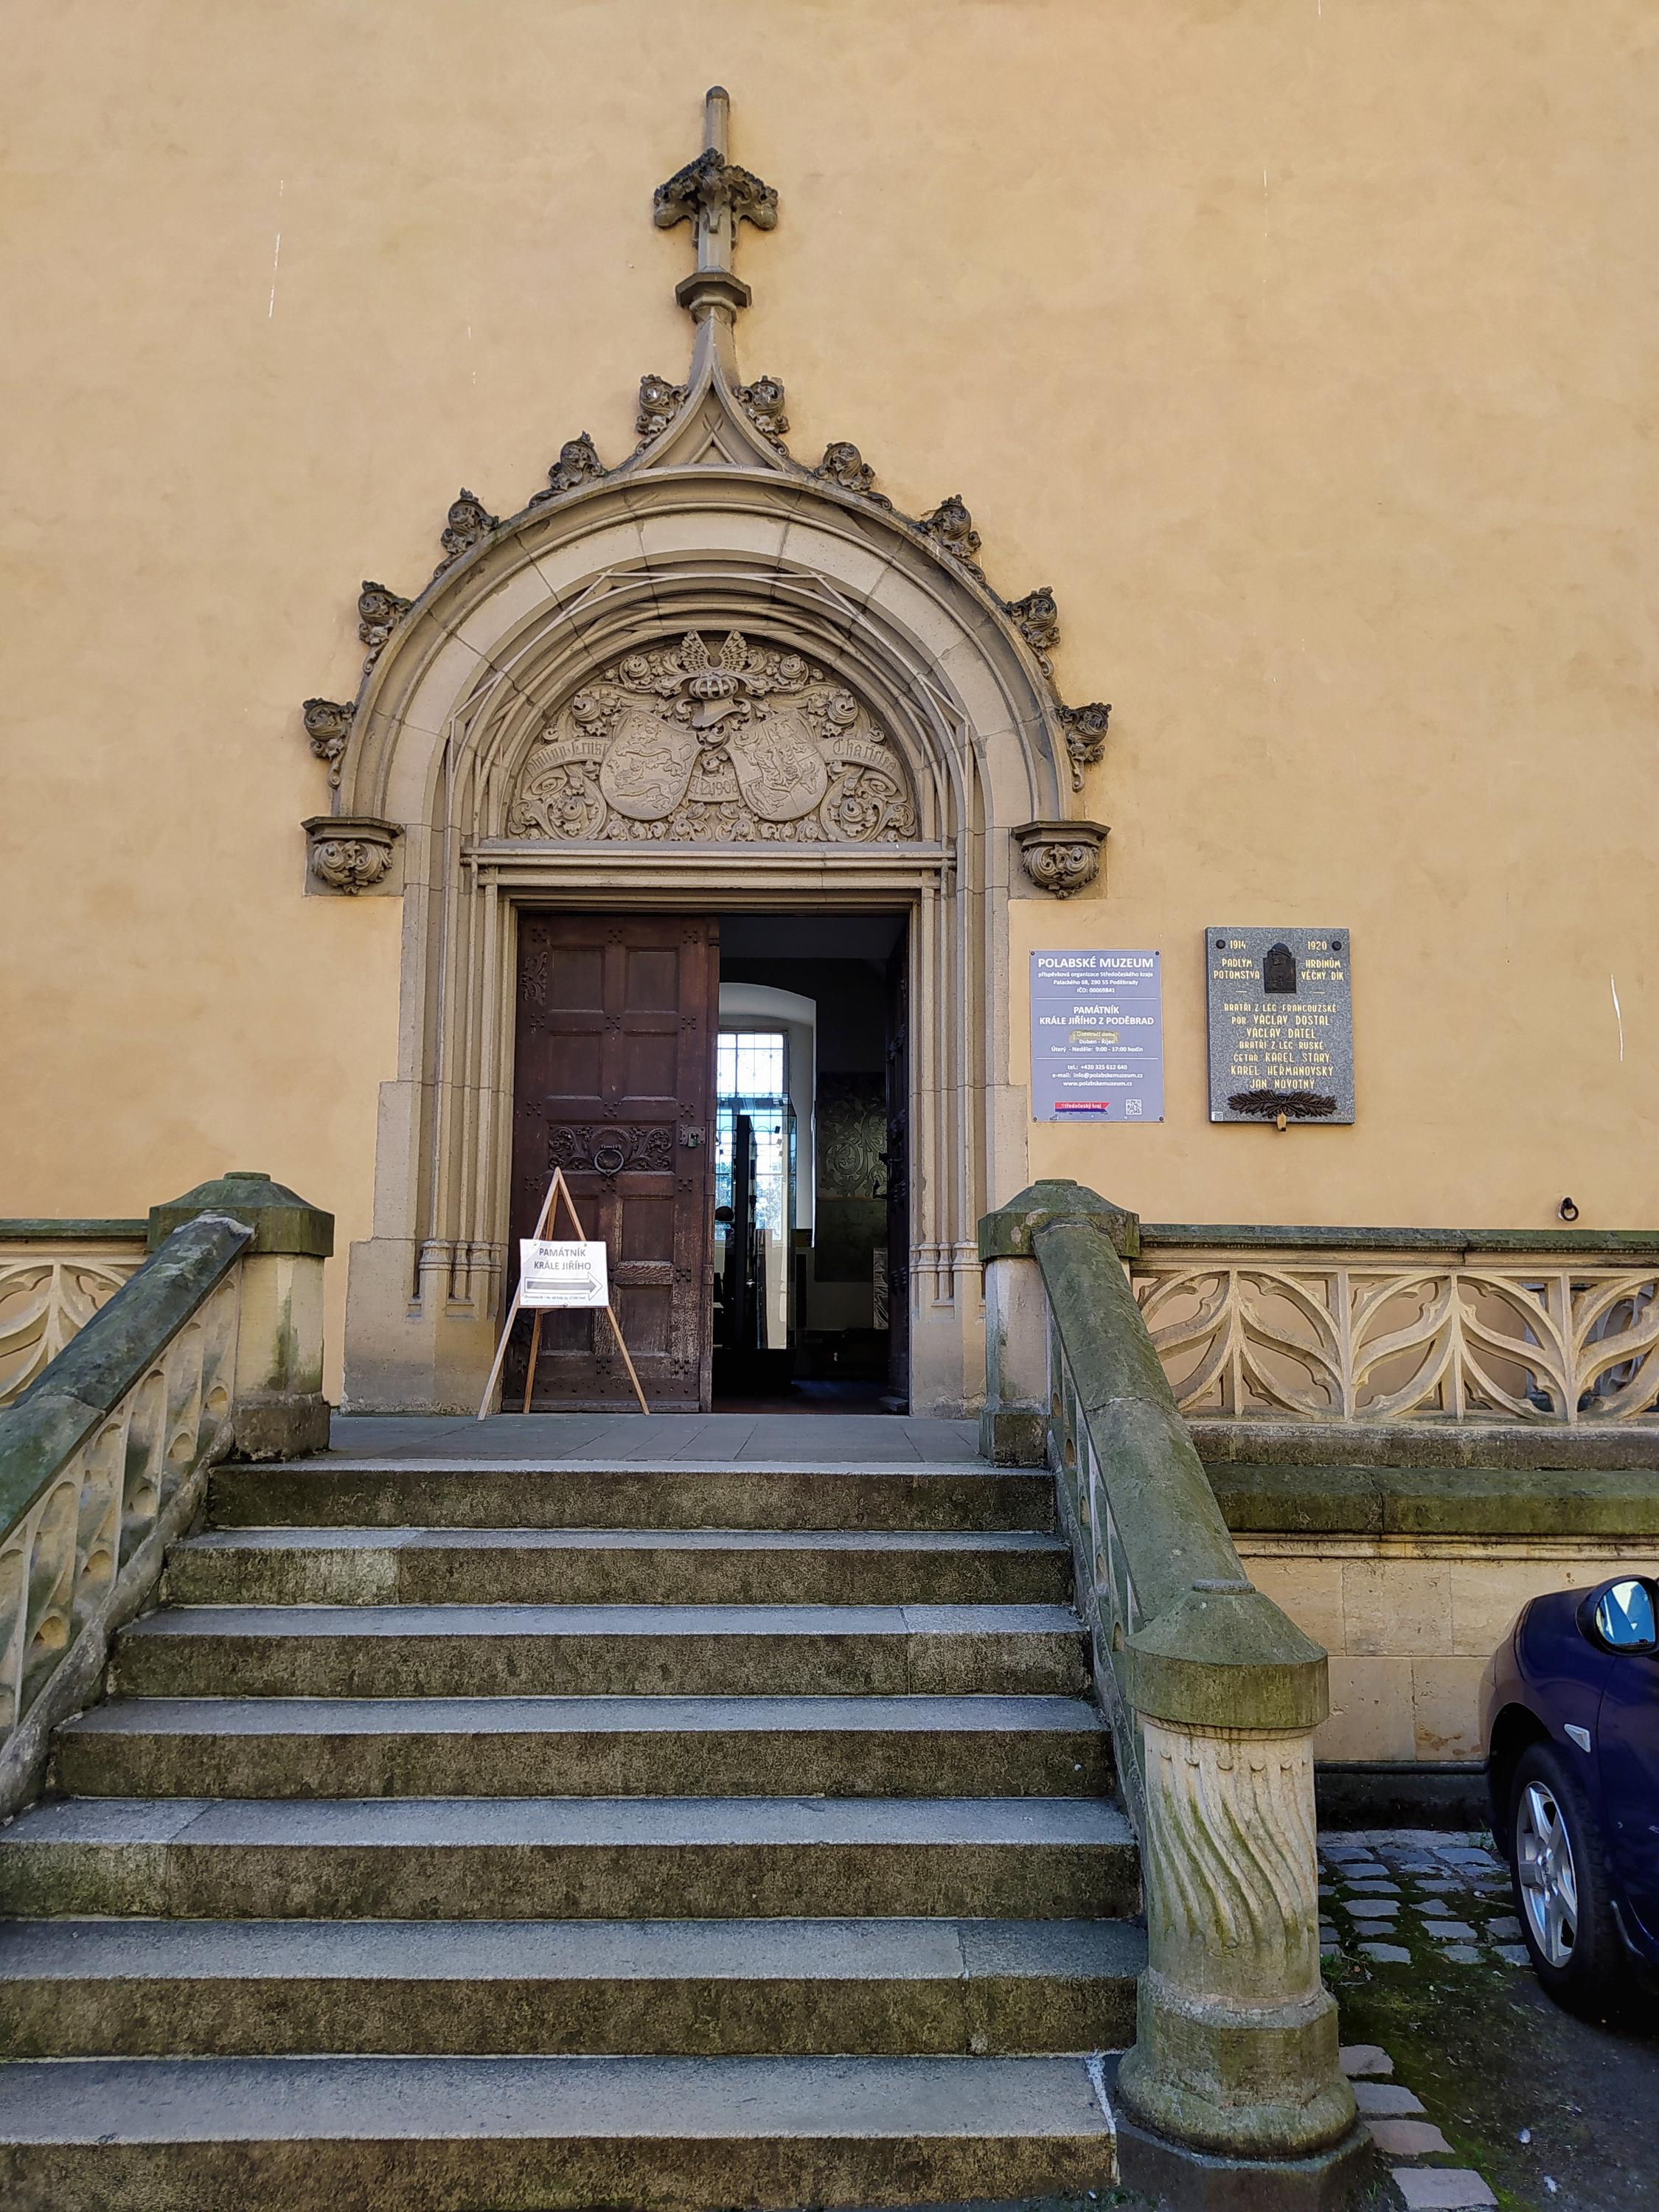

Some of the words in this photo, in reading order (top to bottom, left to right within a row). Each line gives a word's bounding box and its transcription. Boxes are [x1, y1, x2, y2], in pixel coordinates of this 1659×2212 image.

[1230, 939, 1246, 949] 1914
[1307, 941, 1327, 950] 1920
[1037, 956, 1096, 967] POLABSKÉ
[1099, 958, 1153, 967] MUZEUM
[1222, 956, 1253, 967] PADLÝM
[1305, 957, 1340, 968] HRDINŮM
[1213, 970, 1260, 980] POTOMSTVA
[1301, 969, 1326, 980] VĚČNÝ
[1074, 1004, 1119, 1015] PAMÁTNÍK
[1254, 1004, 1259, 1012] Z
[1281, 1003, 1337, 1013] FRANCOUZSKÉ
[1040, 1015, 1066, 1025] KRÁLE
[1068, 1015, 1096, 1025] JIŘÍHO
[1098, 1017, 1104, 1025] Z
[1106, 1015, 1154, 1025] PODĚBRAD
[1271, 1041, 1276, 1049] Z
[1298, 1040, 1324, 1050] RUSKÉ
[1265, 1051, 1294, 1062] KAREL
[1301, 1051, 1330, 1062] STARÝ
[1231, 1065, 1259, 1076] KAREL
[1250, 1079, 1267, 1089] JAN
[1274, 1077, 1315, 1089] NOVOTNÝ
[539, 1247, 585, 1257] PAMÁTNÍK
[534, 1260, 560, 1270] KRÁLE
[562, 1260, 591, 1270] JIŘÍHO
